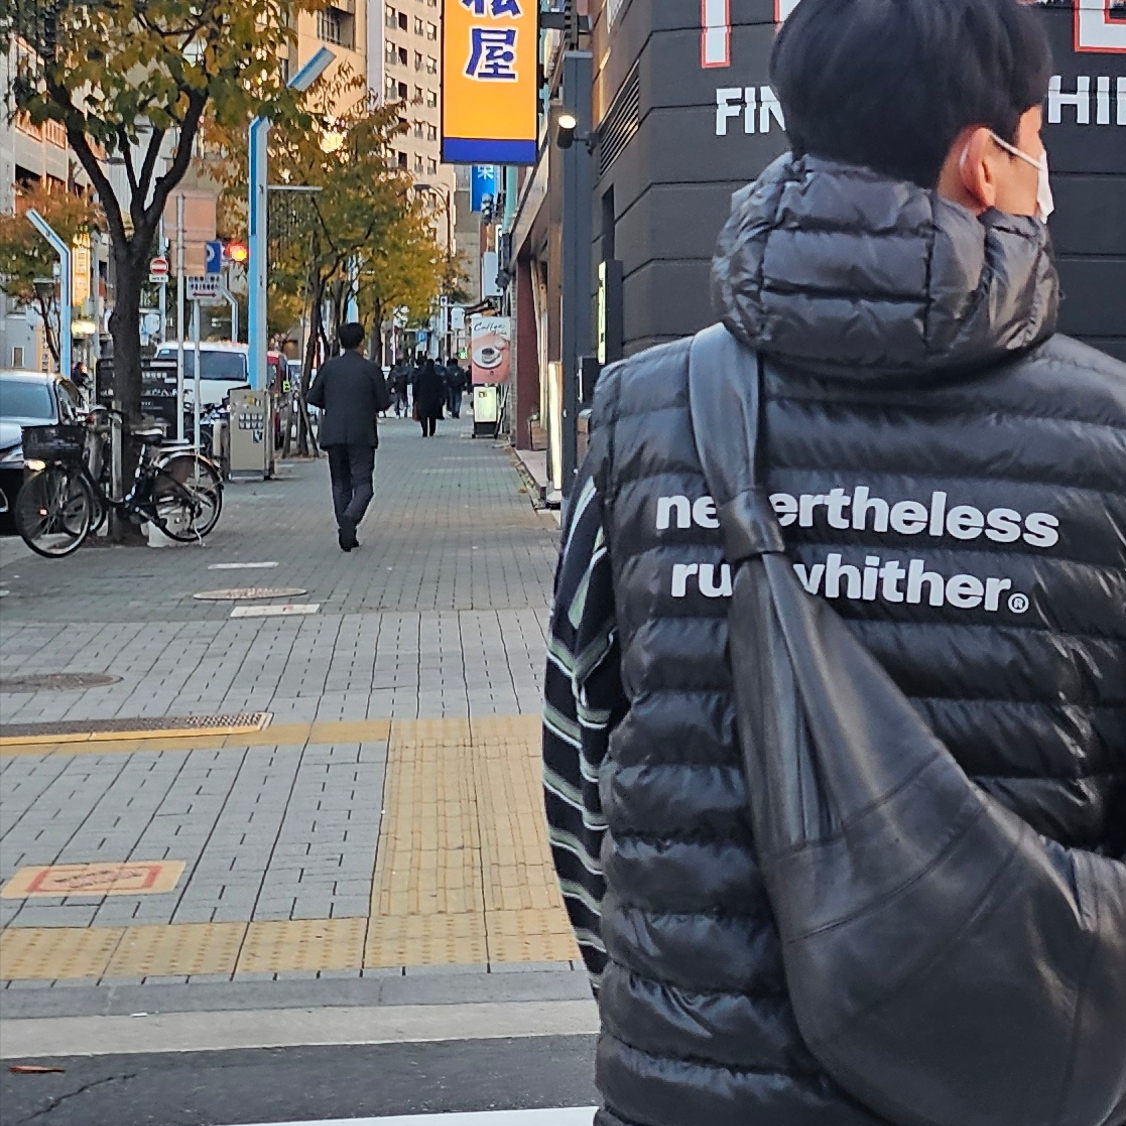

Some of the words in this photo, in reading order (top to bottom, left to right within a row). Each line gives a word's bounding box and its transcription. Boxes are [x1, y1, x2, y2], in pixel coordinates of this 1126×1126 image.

[460, 0, 522, 81] 屋
[715, 85, 787, 136] FIN
[656, 486, 1060, 548] neertheless
